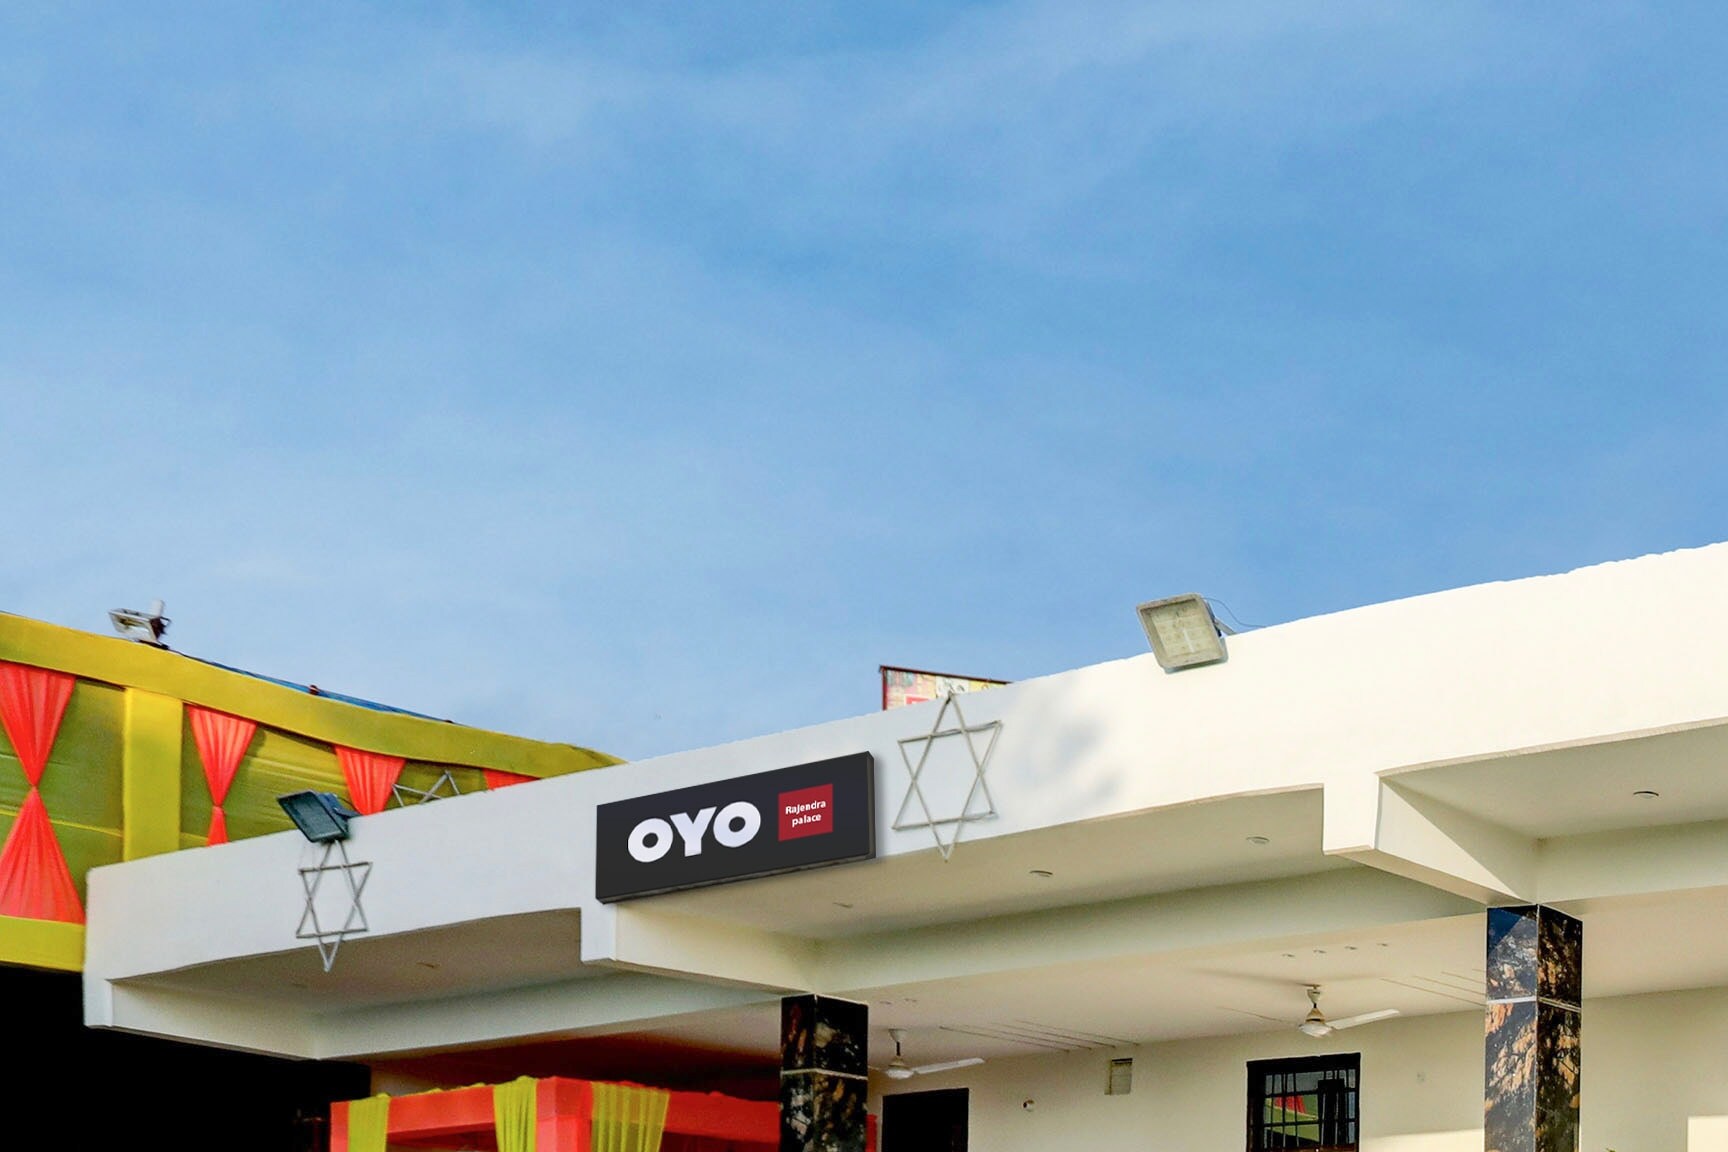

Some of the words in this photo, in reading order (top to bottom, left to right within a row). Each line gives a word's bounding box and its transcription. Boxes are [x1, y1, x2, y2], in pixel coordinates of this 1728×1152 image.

[785, 800, 827, 815] Rajendra
[792, 814, 822, 828] palace
[627, 801, 762, 863] OYO
